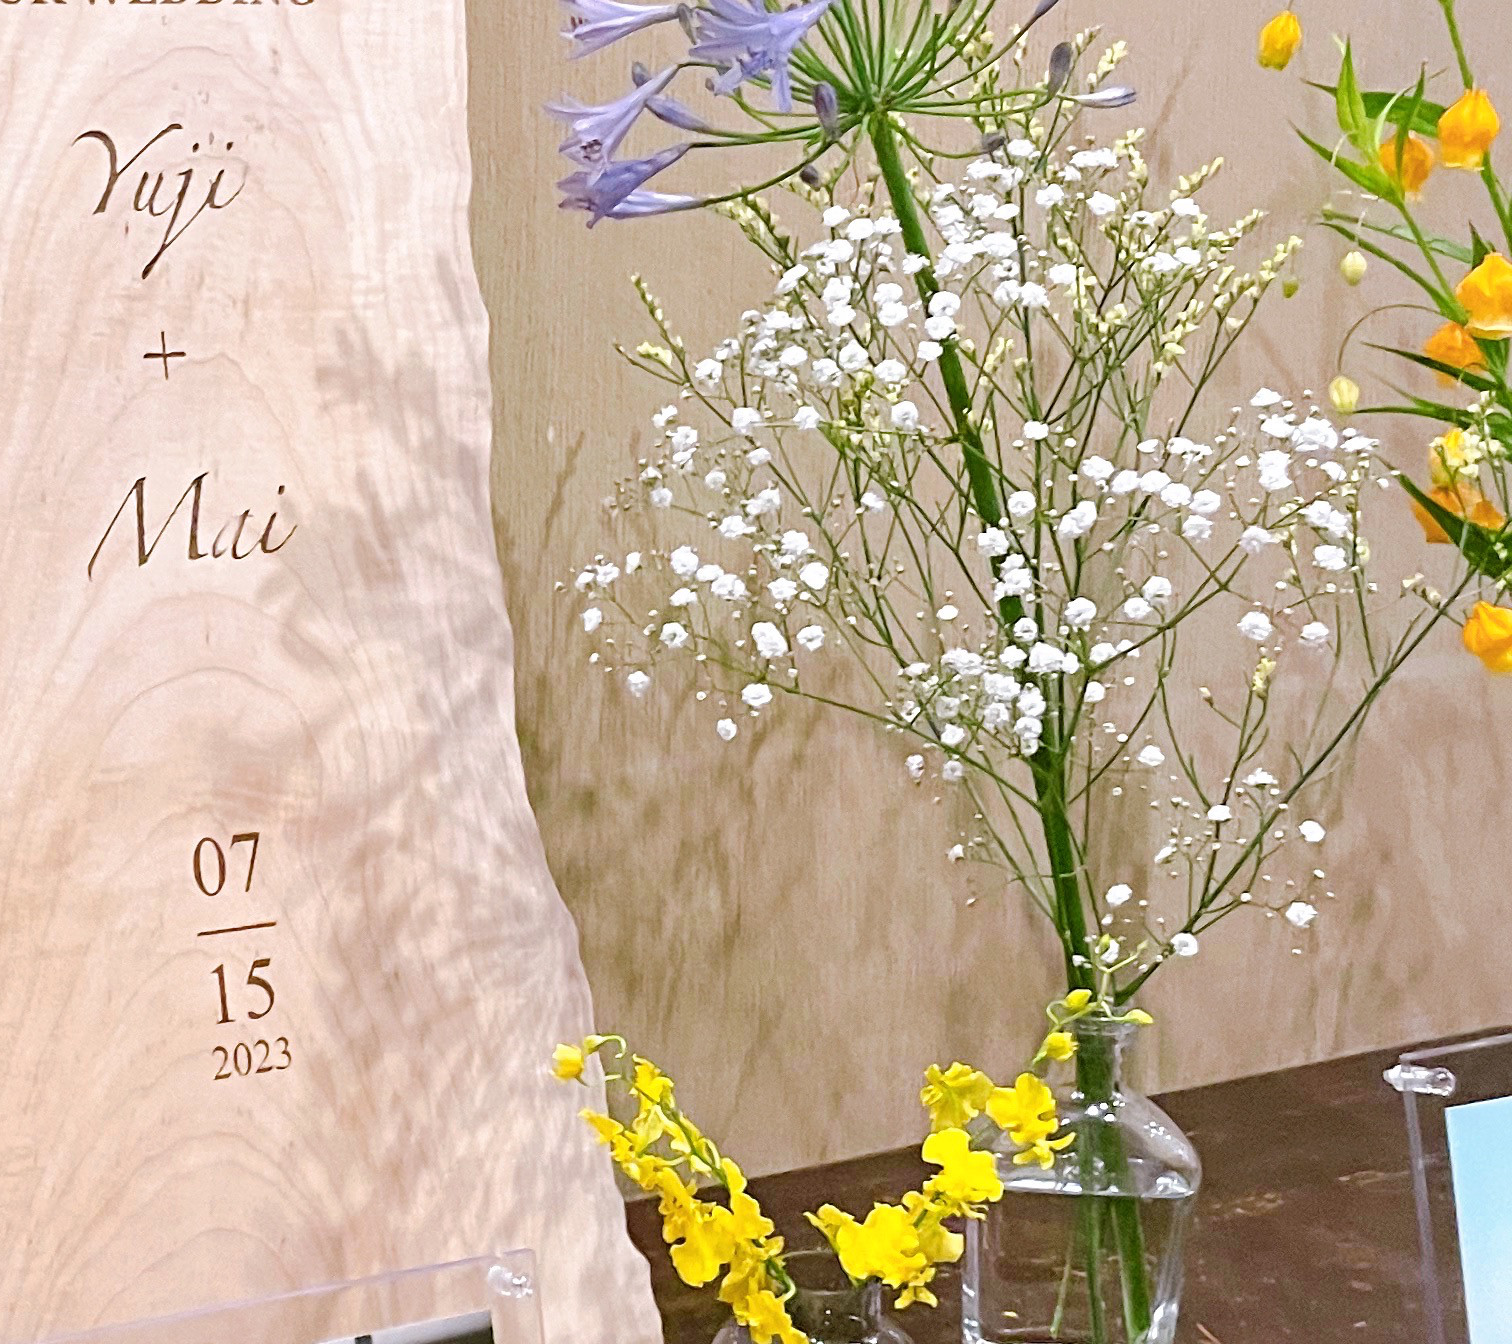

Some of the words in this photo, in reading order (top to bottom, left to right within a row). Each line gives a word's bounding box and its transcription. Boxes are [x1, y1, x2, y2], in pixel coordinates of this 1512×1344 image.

[71, 123, 249, 280] Yuji
[88, 472, 297, 581] Mai
[193, 832, 260, 897] 07
[211, 958, 275, 1025] 15
[212, 1036, 292, 1081] 2023
